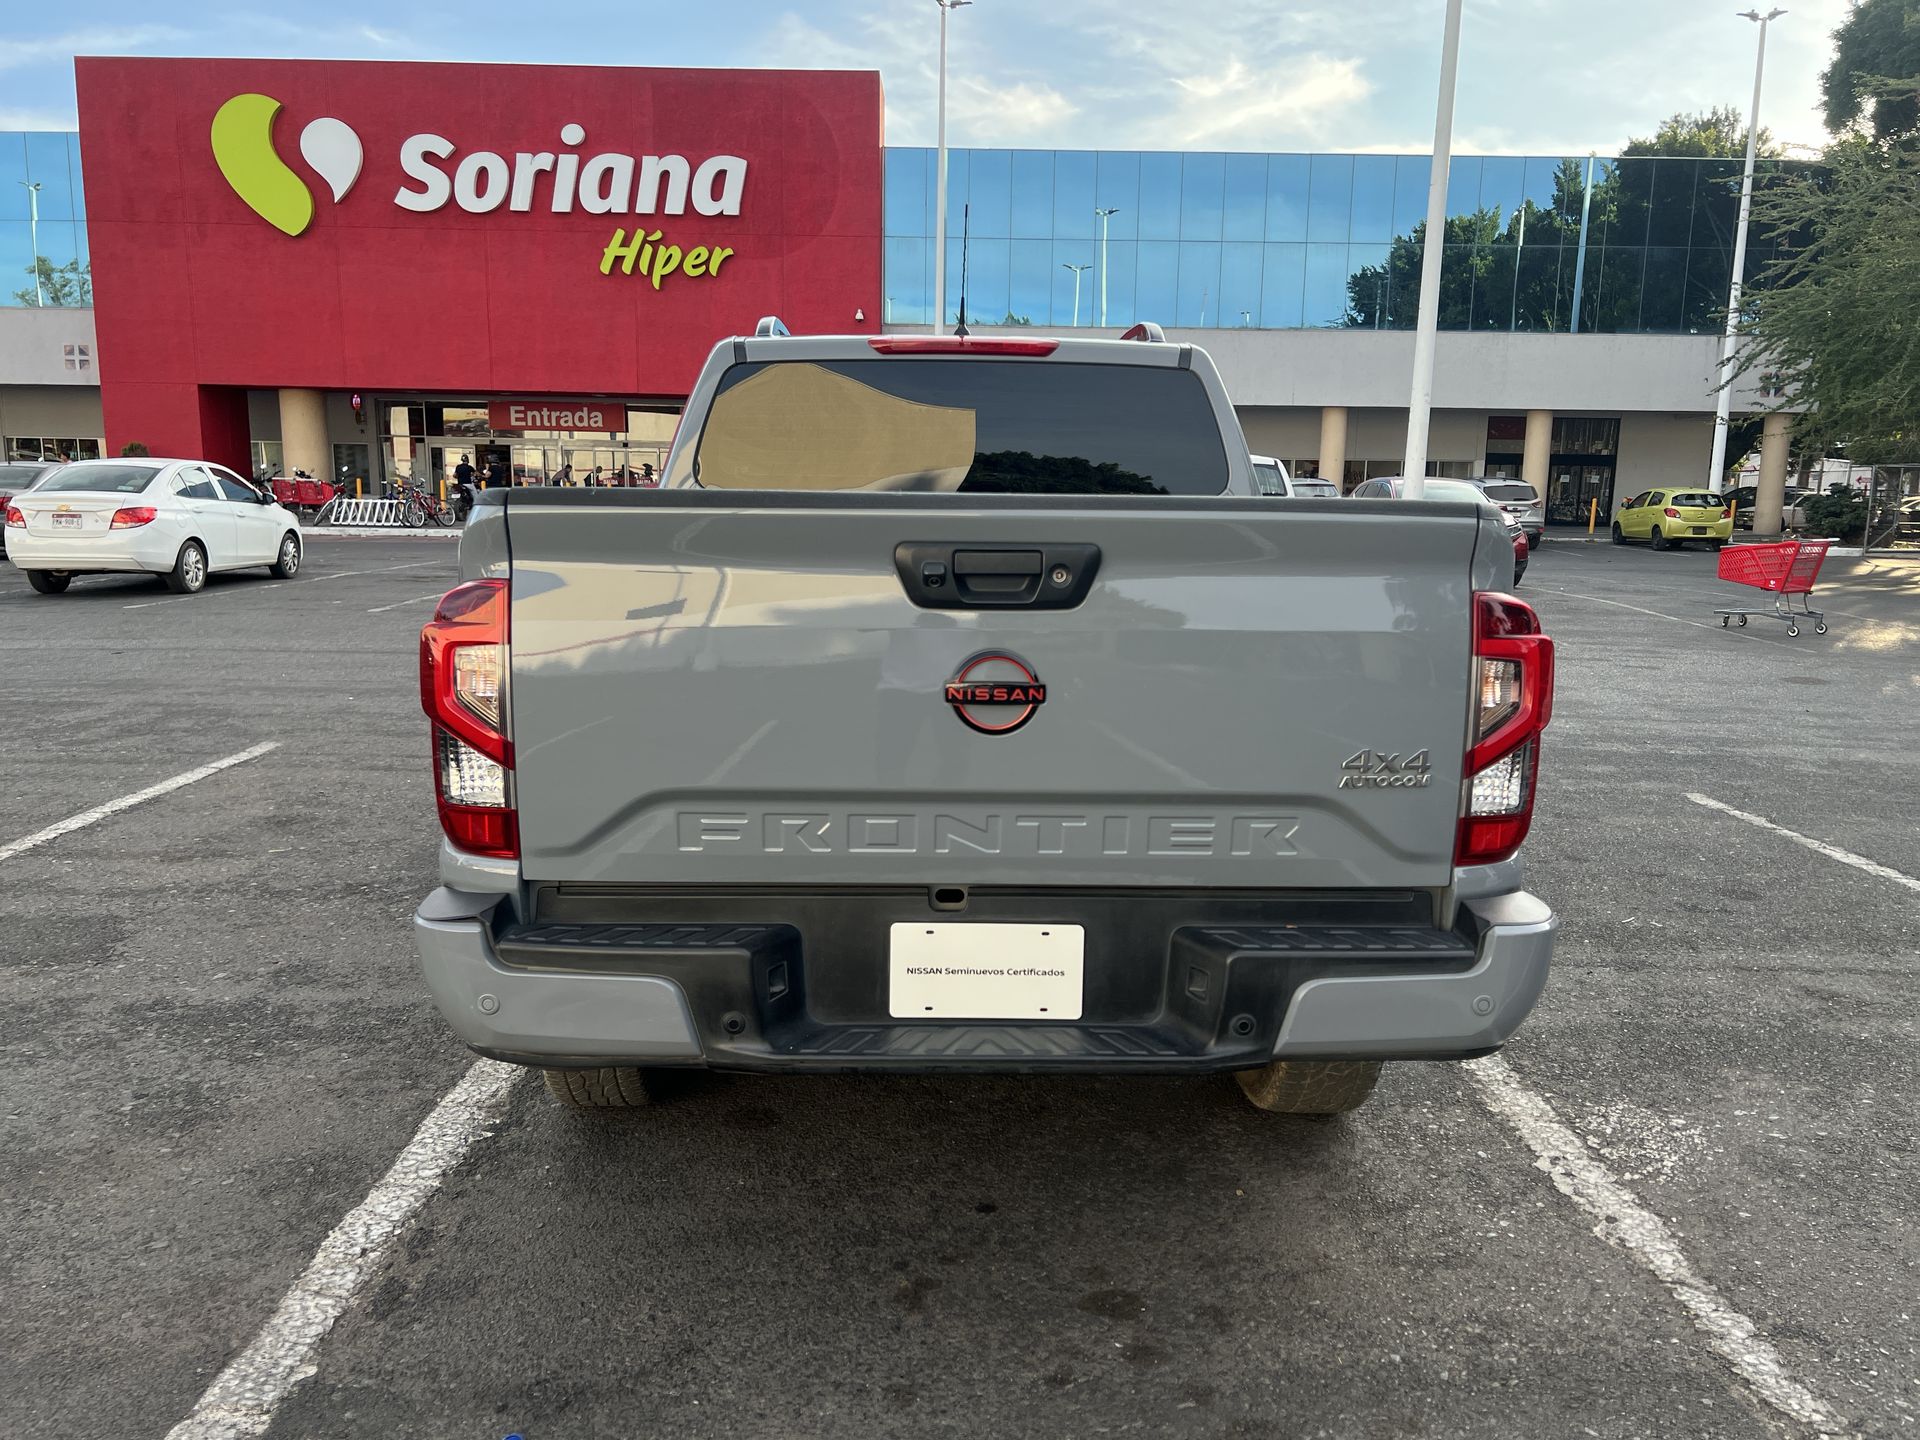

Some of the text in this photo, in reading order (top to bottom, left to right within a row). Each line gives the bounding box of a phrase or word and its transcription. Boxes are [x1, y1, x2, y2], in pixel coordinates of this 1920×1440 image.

[394, 123, 748, 215] Soriana
[599, 228, 735, 290] Híper
[510, 406, 603, 428] Entrada
[947, 687, 1044, 701] NISSAN
[1341, 748, 1432, 774] 4x4
[677, 812, 1302, 857] FRONTIER
[906, 967, 1065, 977] NISSAN Seminuevos Certificados
